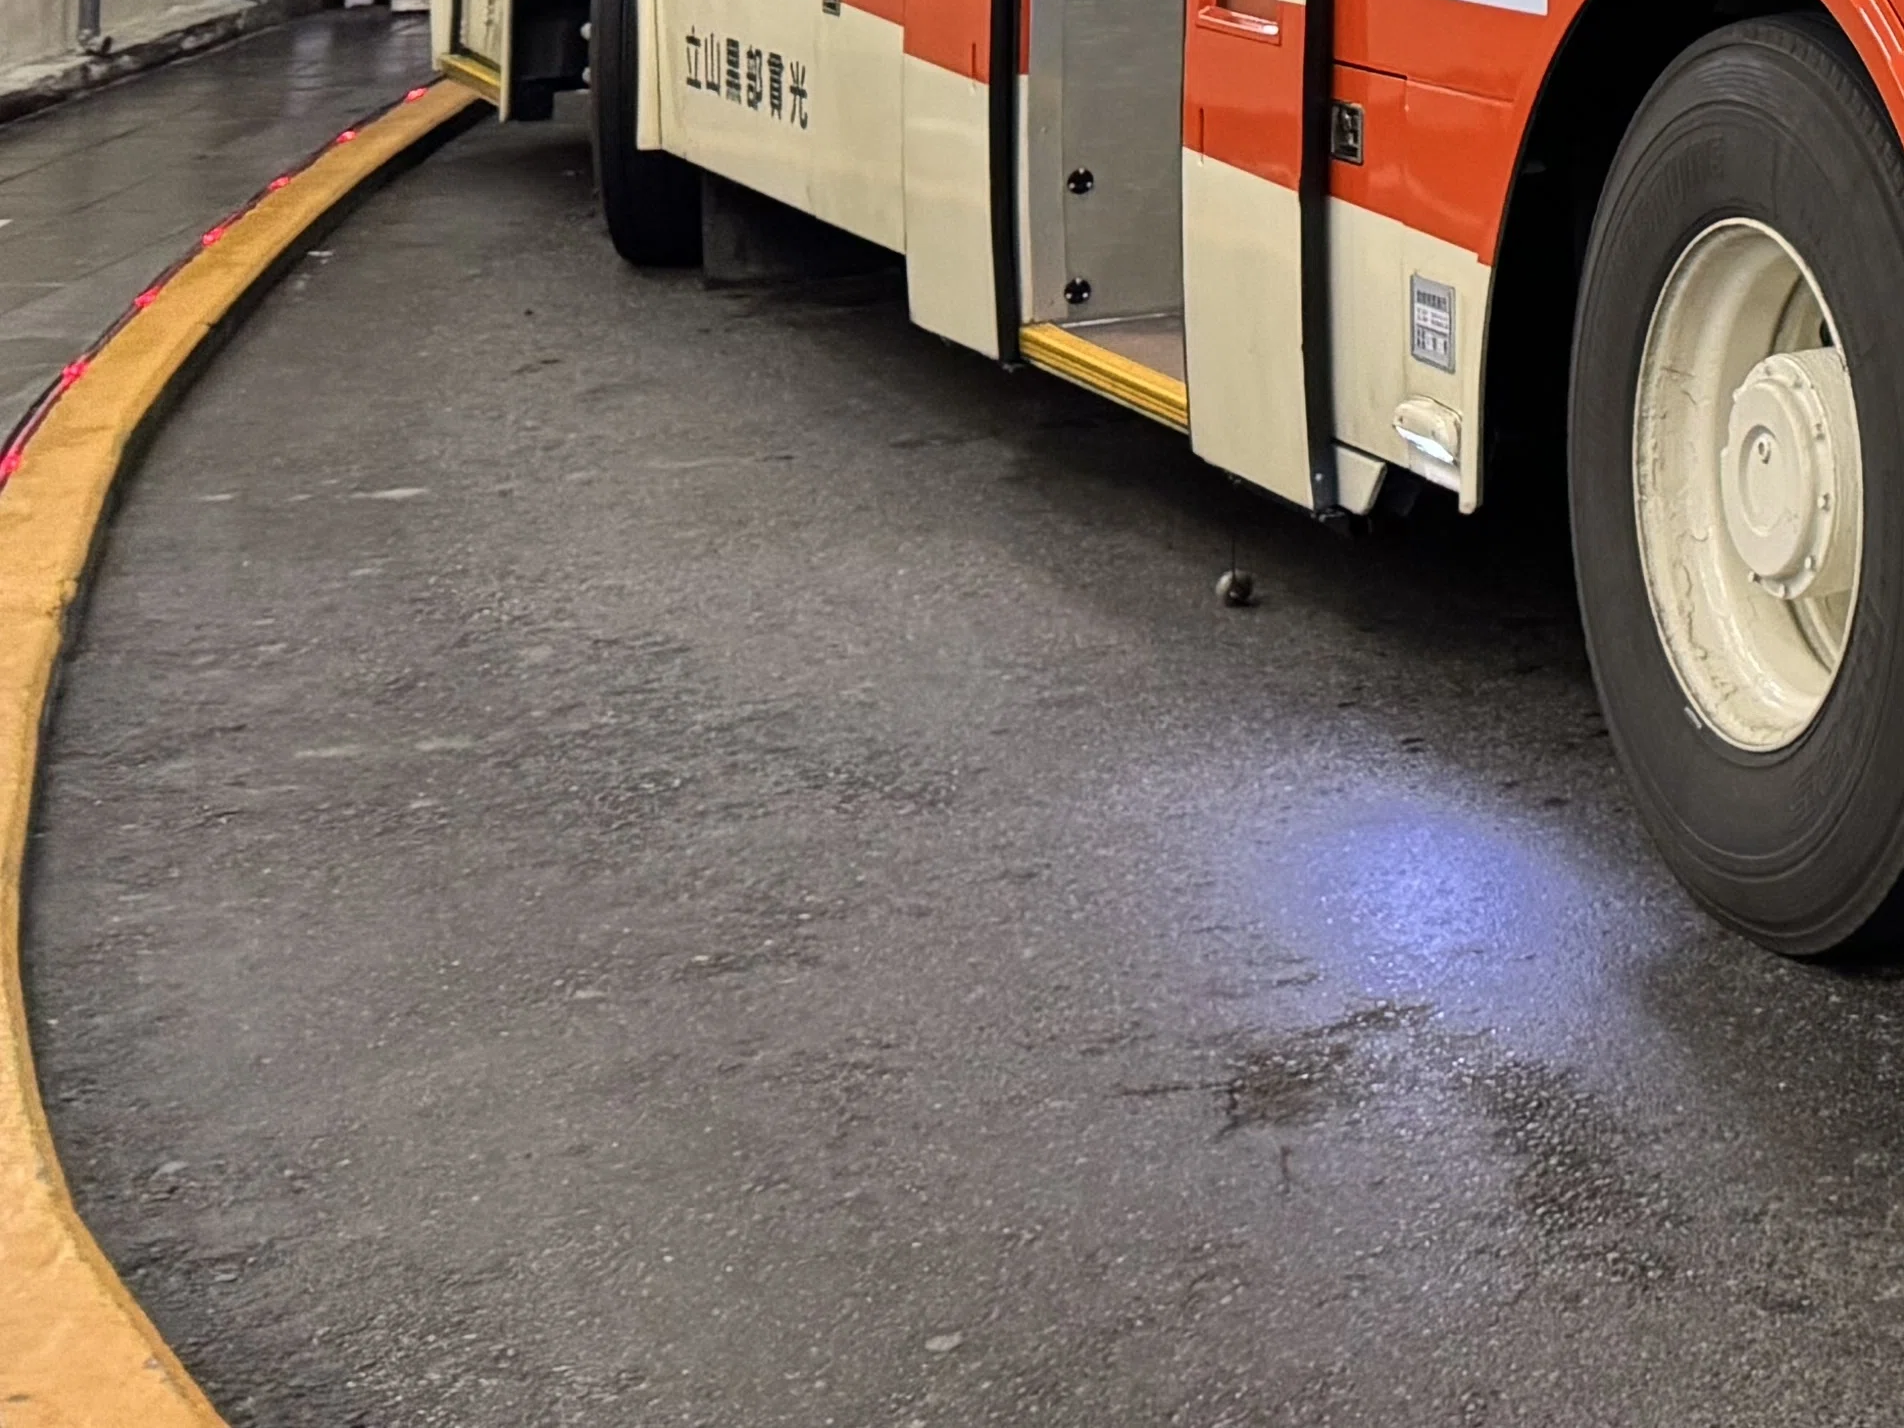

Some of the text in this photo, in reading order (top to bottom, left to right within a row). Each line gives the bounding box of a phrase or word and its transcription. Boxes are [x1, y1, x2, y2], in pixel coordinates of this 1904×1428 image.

[685, 23, 809, 131] 立山黒部貫光
